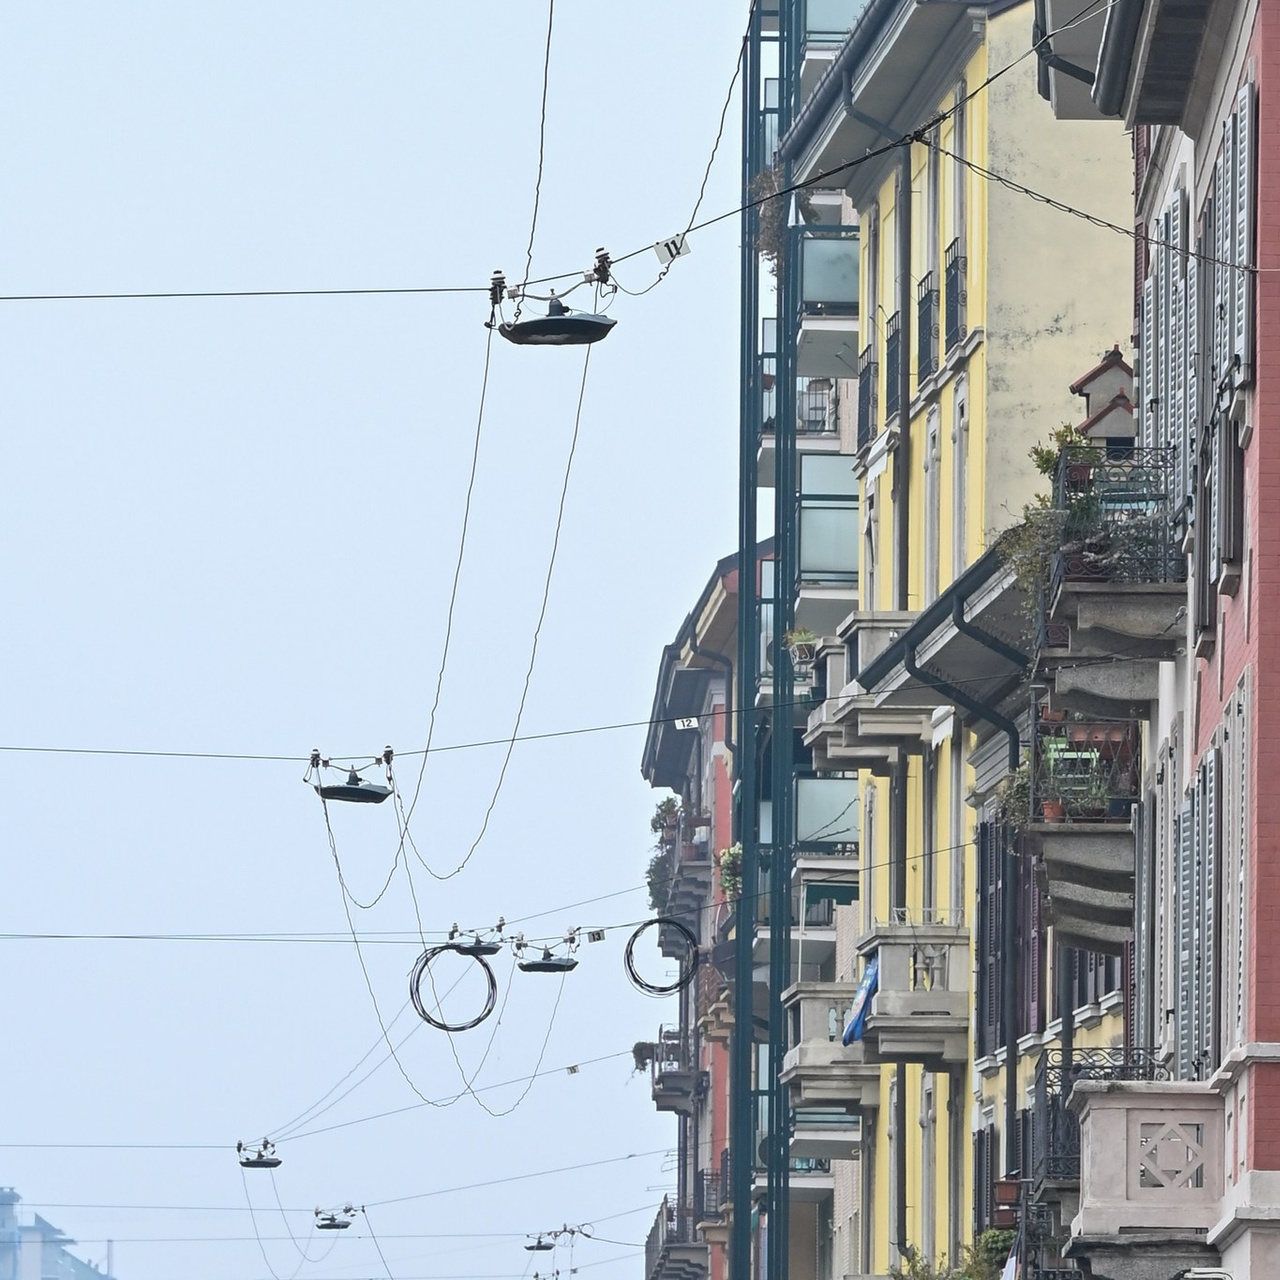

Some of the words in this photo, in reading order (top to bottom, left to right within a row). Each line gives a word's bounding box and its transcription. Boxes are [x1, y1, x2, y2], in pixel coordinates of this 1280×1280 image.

[663, 240, 681, 258] 11
[681, 719, 693, 728] 12
[592, 932, 601, 942] 13
